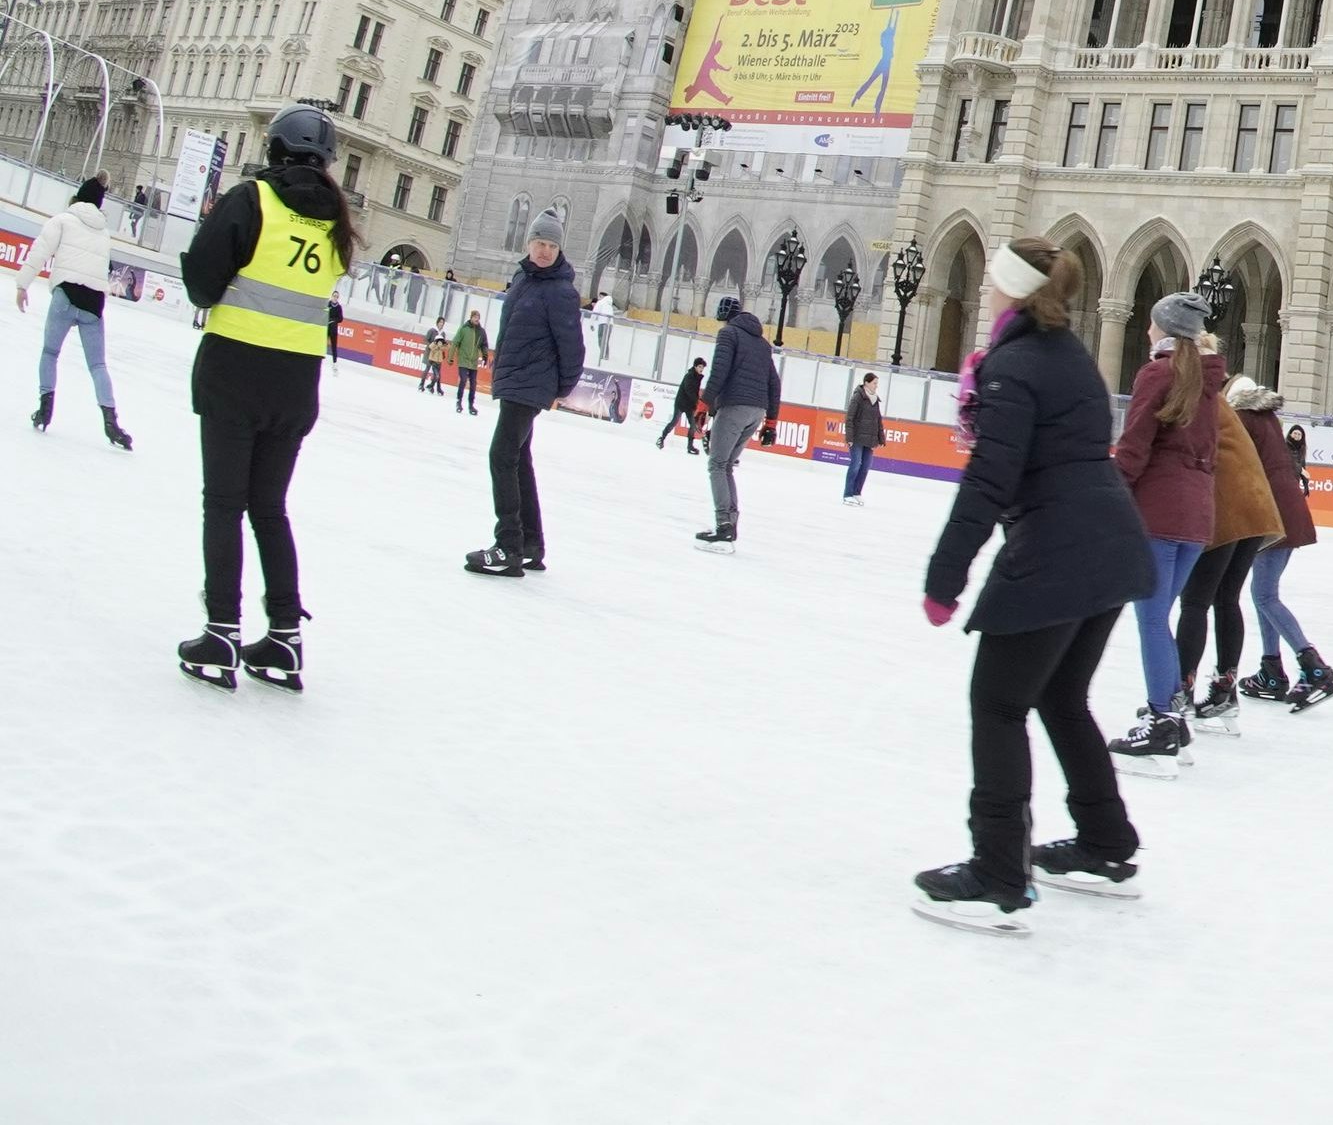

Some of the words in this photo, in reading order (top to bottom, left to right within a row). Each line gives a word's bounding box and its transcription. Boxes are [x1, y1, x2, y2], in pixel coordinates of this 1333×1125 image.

[741, 34, 753, 47] 2.
[757, 28, 779, 48] bis
[780, 33, 793, 52] 5.
[797, 28, 838, 48] März
[835, 23, 860, 35] 2023
[737, 55, 772, 67] Wiener
[774, 55, 826, 67] Stadthalle
[287, 235, 321, 274] 76
